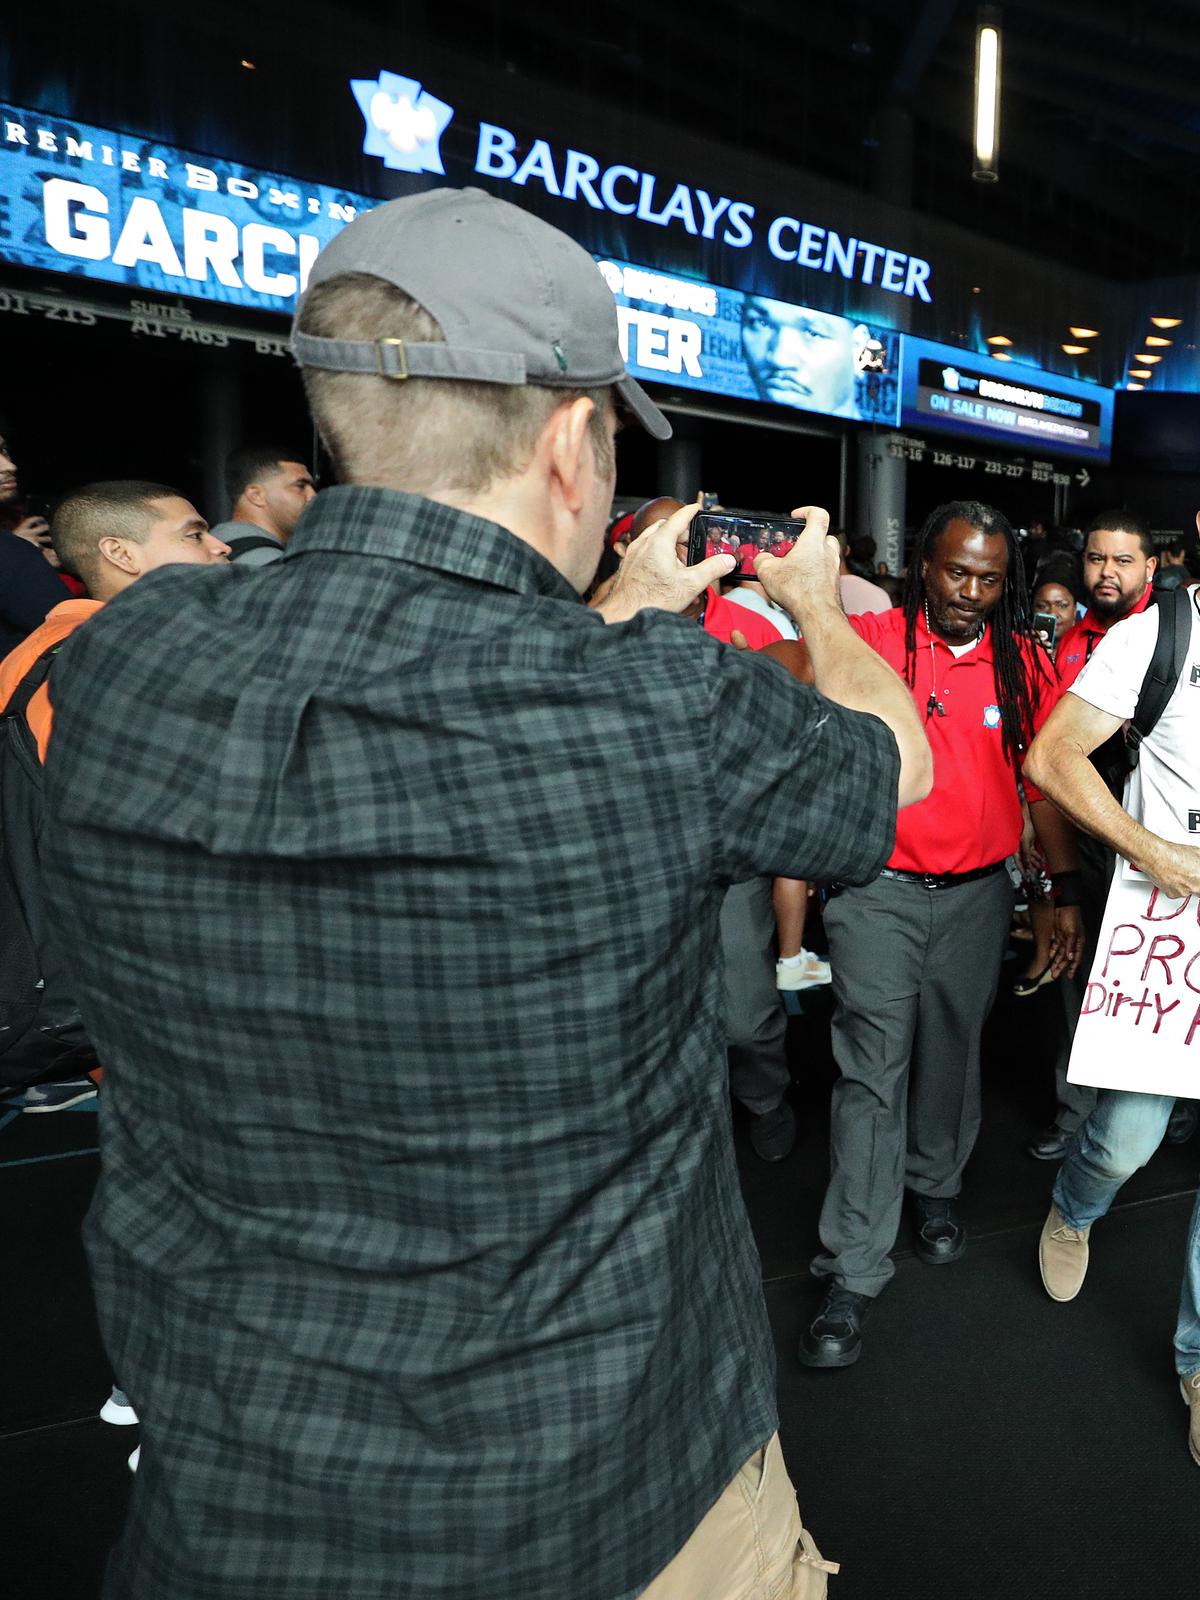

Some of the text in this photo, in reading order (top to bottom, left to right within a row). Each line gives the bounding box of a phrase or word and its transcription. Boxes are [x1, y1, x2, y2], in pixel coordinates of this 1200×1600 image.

[186, 163, 372, 223] BOXIN
[475, 122, 755, 249] BARCLAYS
[768, 215, 932, 303] CENTER
[130, 300, 193, 321] SUITES
[930, 394, 949, 412] ON
[952, 399, 984, 421] SALE
[986, 406, 1017, 427] NOW
[933, 452, 976, 470] 126-117
